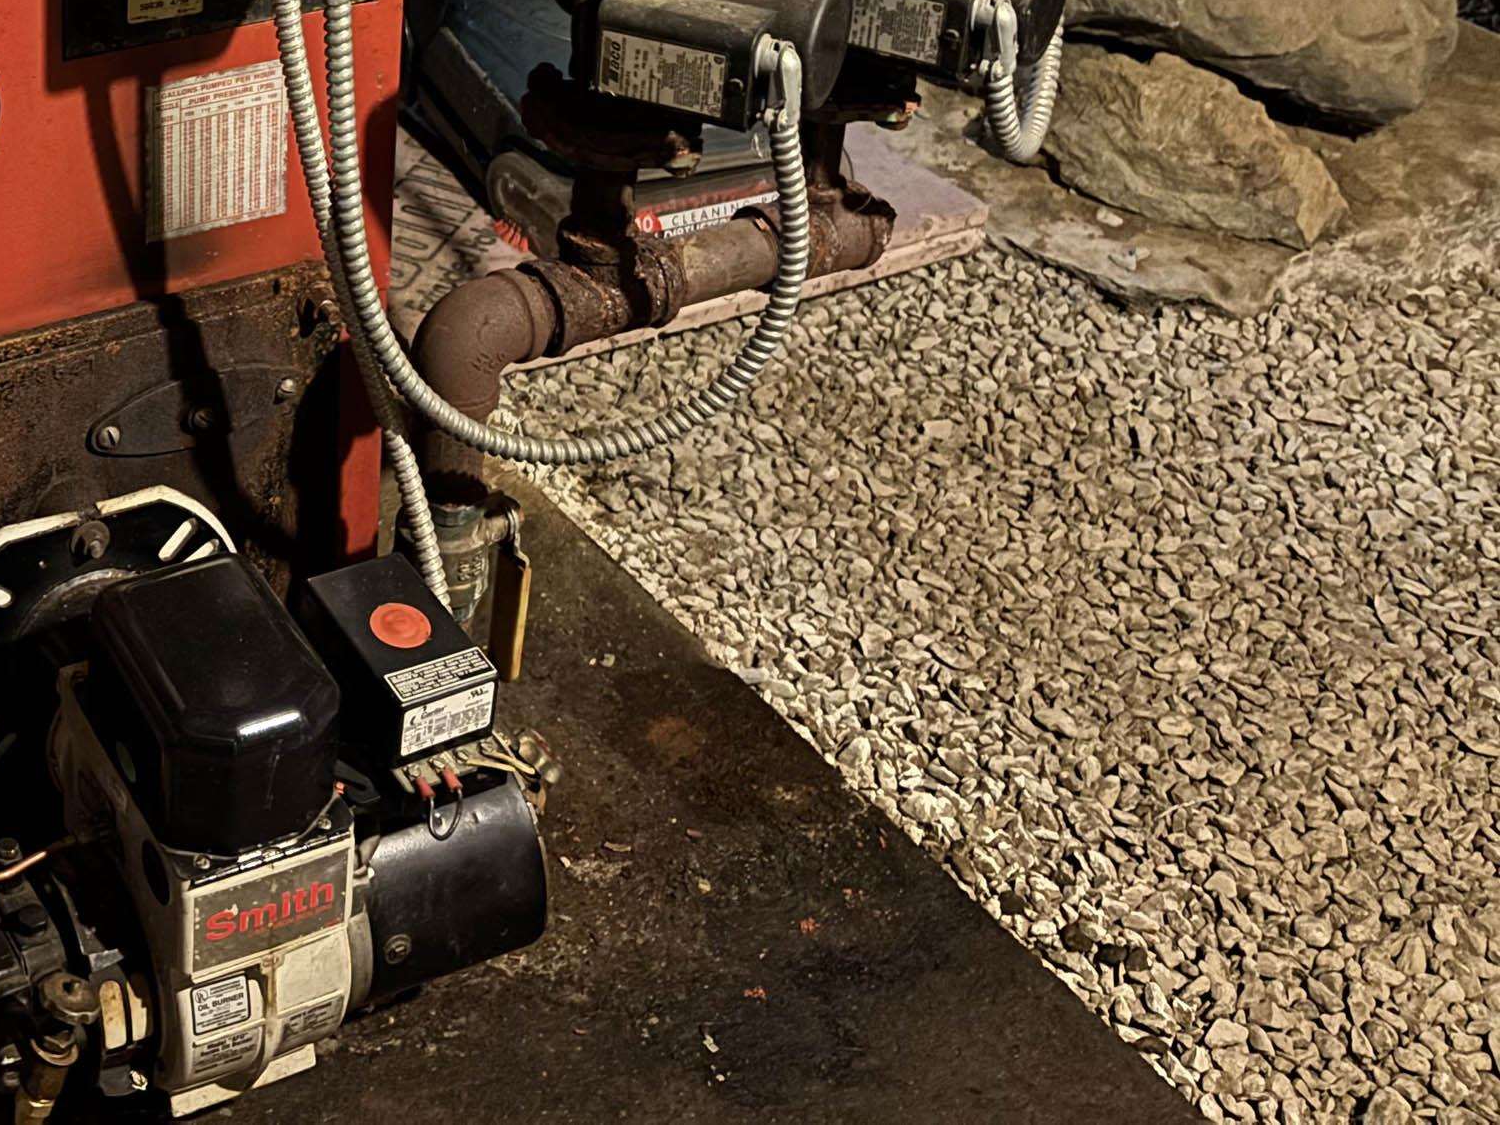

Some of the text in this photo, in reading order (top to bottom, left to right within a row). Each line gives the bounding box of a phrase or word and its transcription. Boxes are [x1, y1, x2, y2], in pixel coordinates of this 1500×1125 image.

[161, 86, 198, 99] GALLONS
[201, 79, 232, 91] PUMPED
[235, 74, 251, 84] PER
[188, 95, 211, 106] PUMP
[213, 86, 254, 99] PRESSURE
[205, 881, 335, 942] Smith
[212, 993, 244, 1007] BURNER
